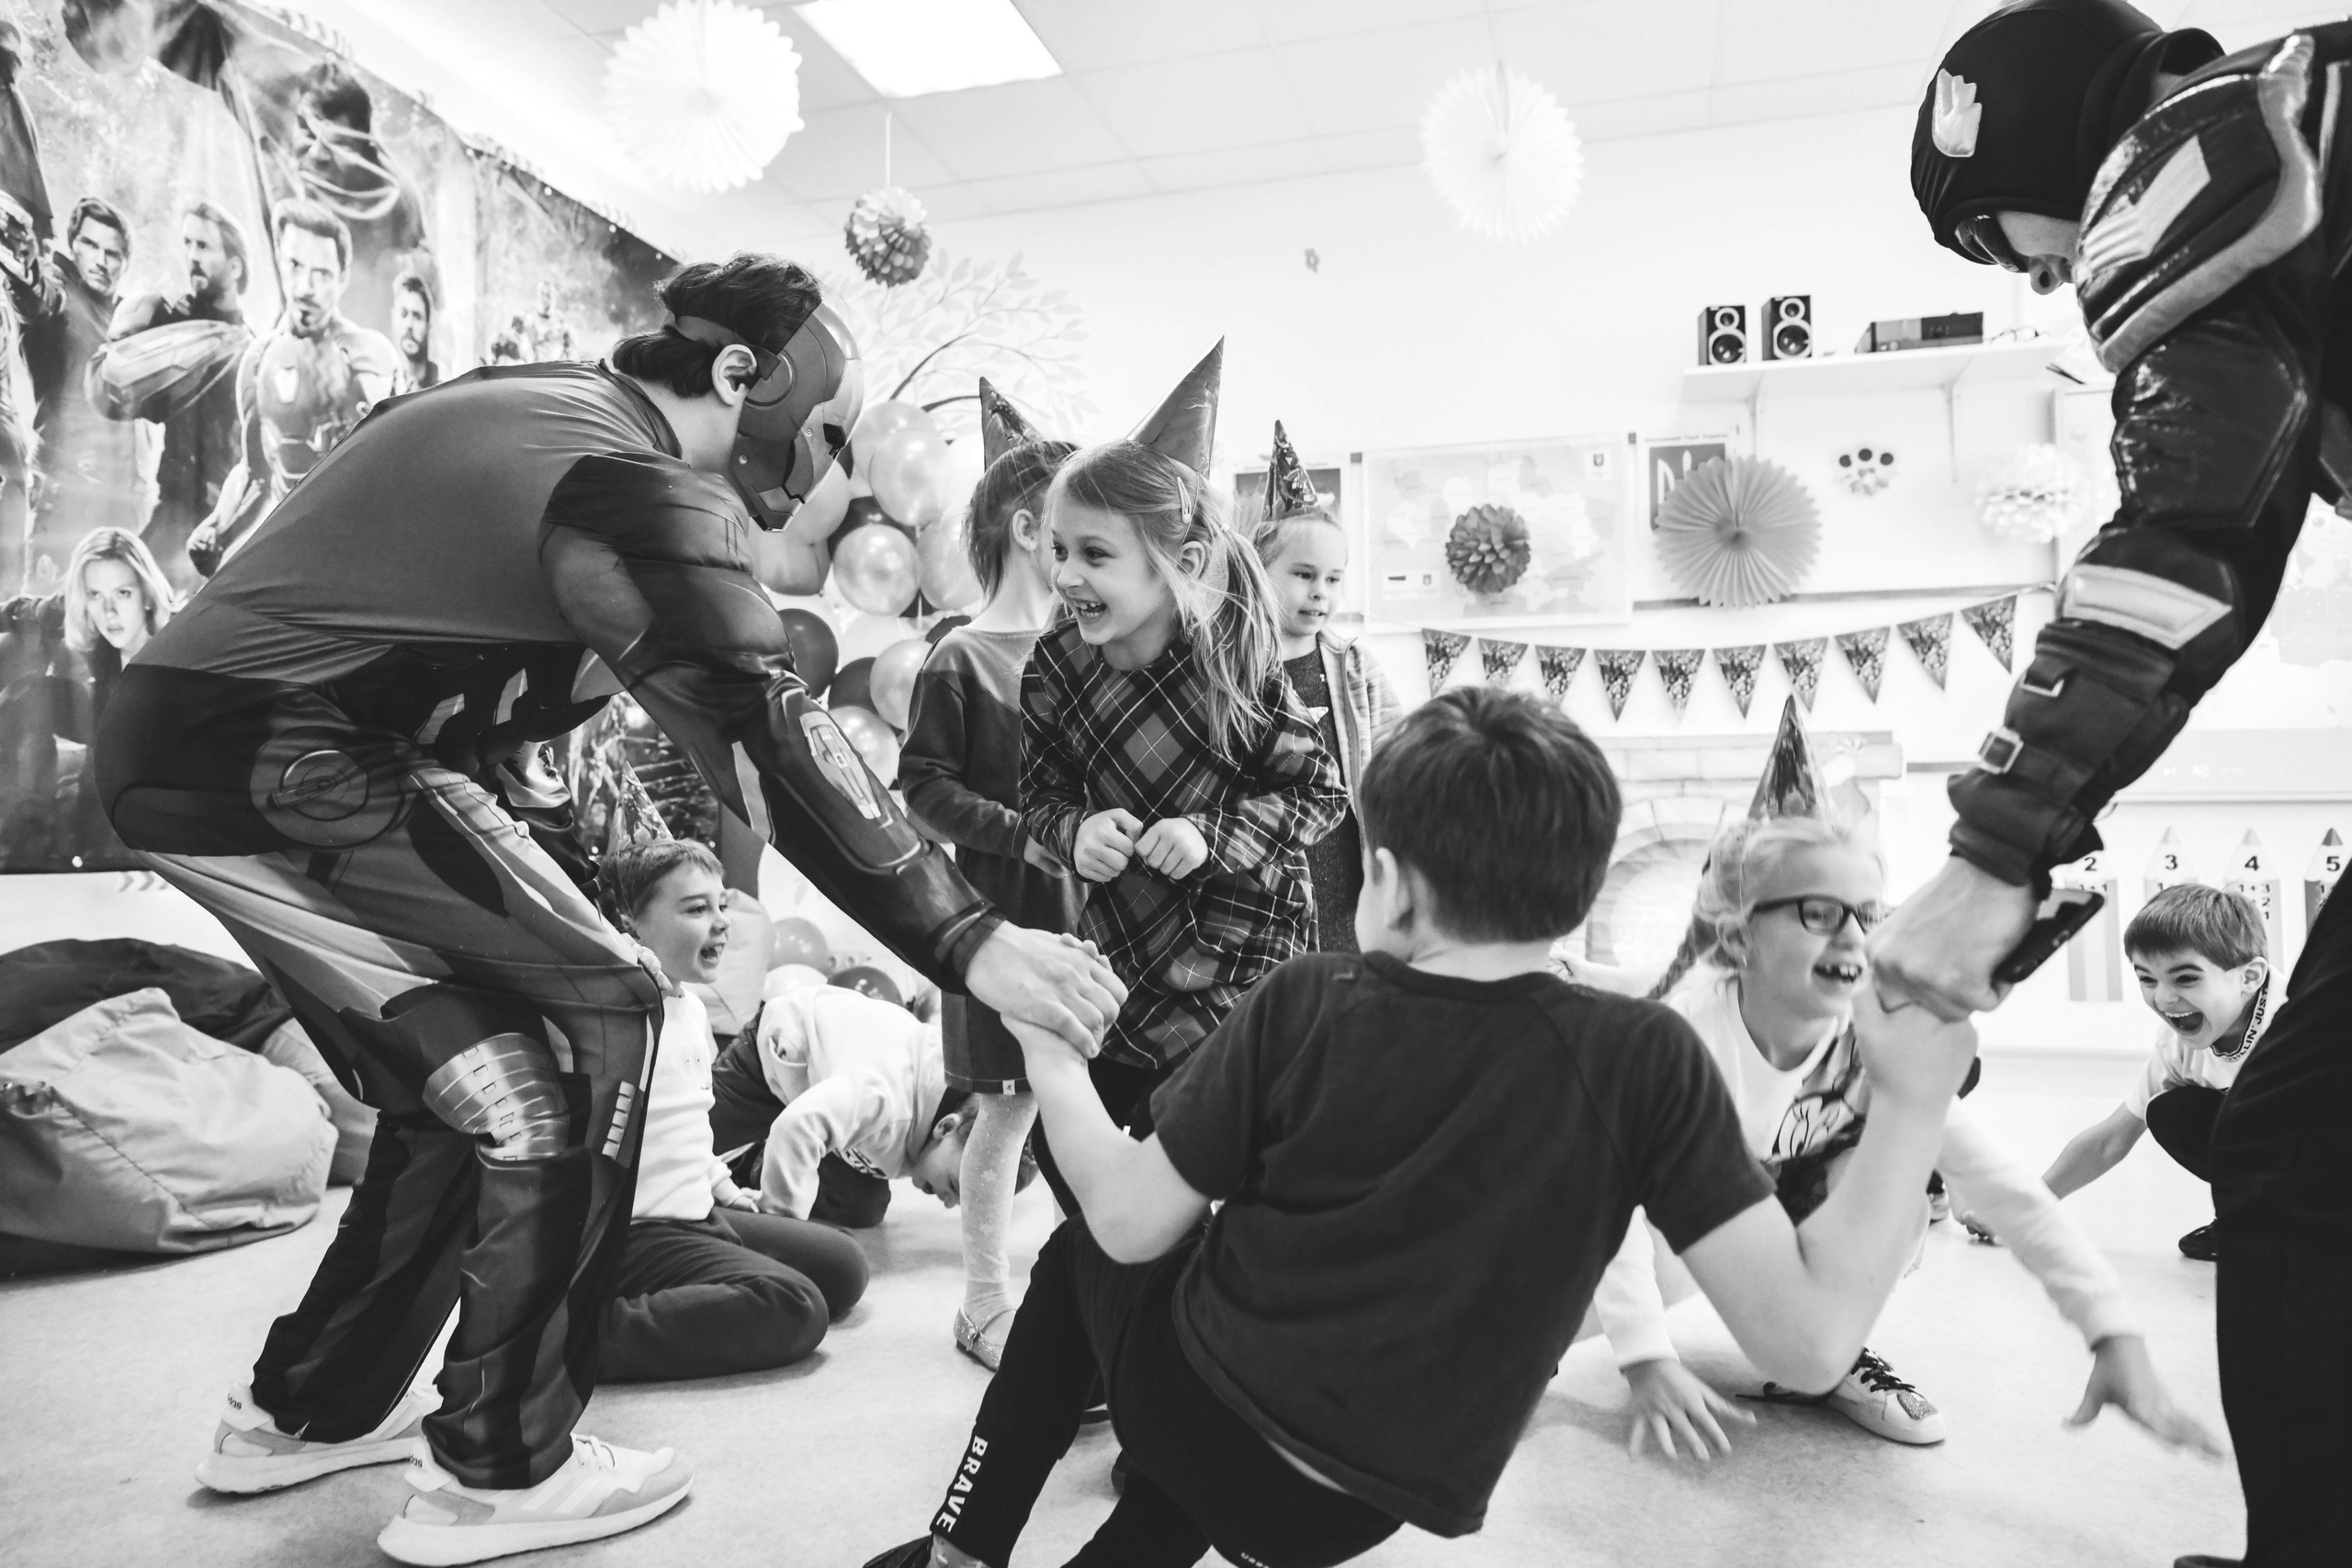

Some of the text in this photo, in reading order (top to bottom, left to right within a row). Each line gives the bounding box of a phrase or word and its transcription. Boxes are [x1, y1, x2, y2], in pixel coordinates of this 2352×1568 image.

[2083, 856, 2098, 872] 2
[2165, 853, 2178, 871] 3
[2244, 855, 2260, 872] 4
[2325, 855, 2341, 873] 5
[935, 1435, 989, 1533] BRAVE
